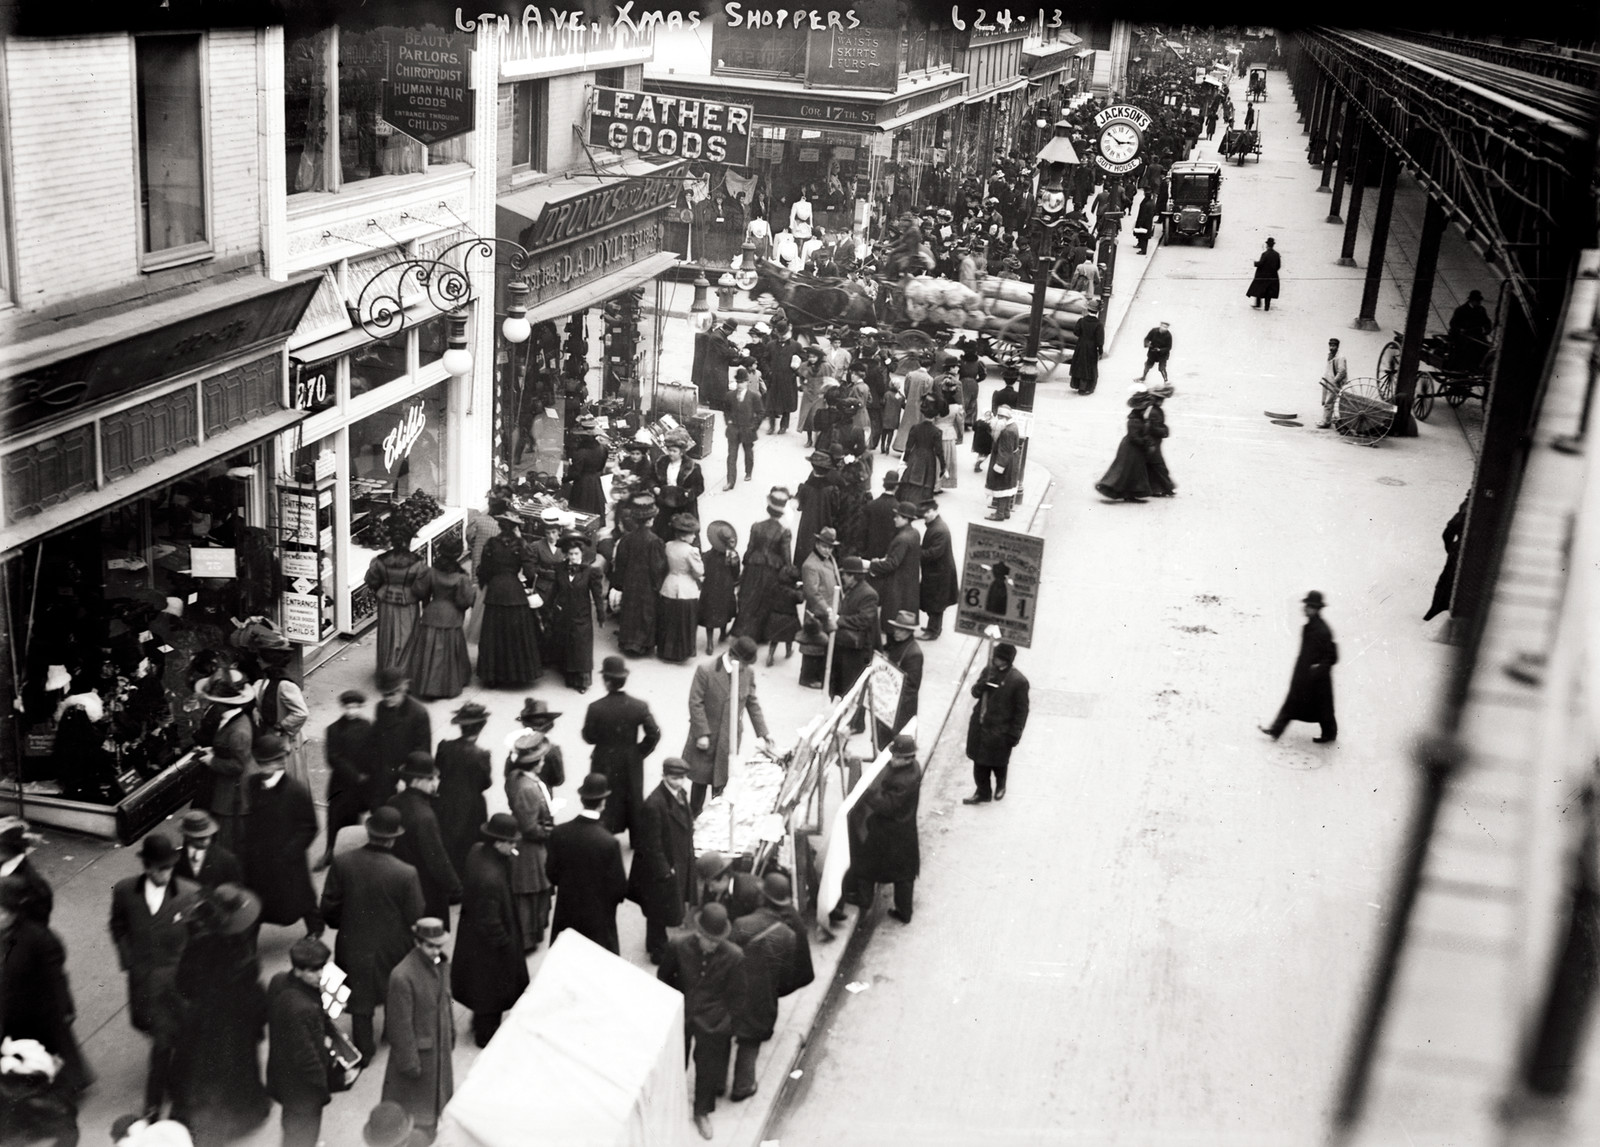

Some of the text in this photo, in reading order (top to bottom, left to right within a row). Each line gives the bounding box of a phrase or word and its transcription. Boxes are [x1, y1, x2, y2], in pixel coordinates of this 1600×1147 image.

[405, 31, 454, 48] BEAUTY
[837, 36, 879, 48] WAISTS
[399, 45, 461, 65] PARLORS.
[837, 47, 877, 59] SKIRTS
[837, 58, 866, 69] FURS
[395, 63, 462, 82] CHIROPODIST
[394, 82, 463, 102] HUMAN HAIR
[409, 96, 447, 108] GOODS
[394, 110, 426, 119] ENTRANCE
[592, 89, 749, 135] LEATHER
[408, 119, 448, 131] CHILD'S
[608, 122, 727, 163] GOODS
[1097, 157, 1137, 172] SUIT HOUSE
[535, 185, 626, 246] TRUNKS
[588, 232, 629, 272] DOYLE
[296, 374, 327, 410] 270
[285, 596, 319, 610] ENTRANCE
[286, 626, 316, 636] CHILDS
